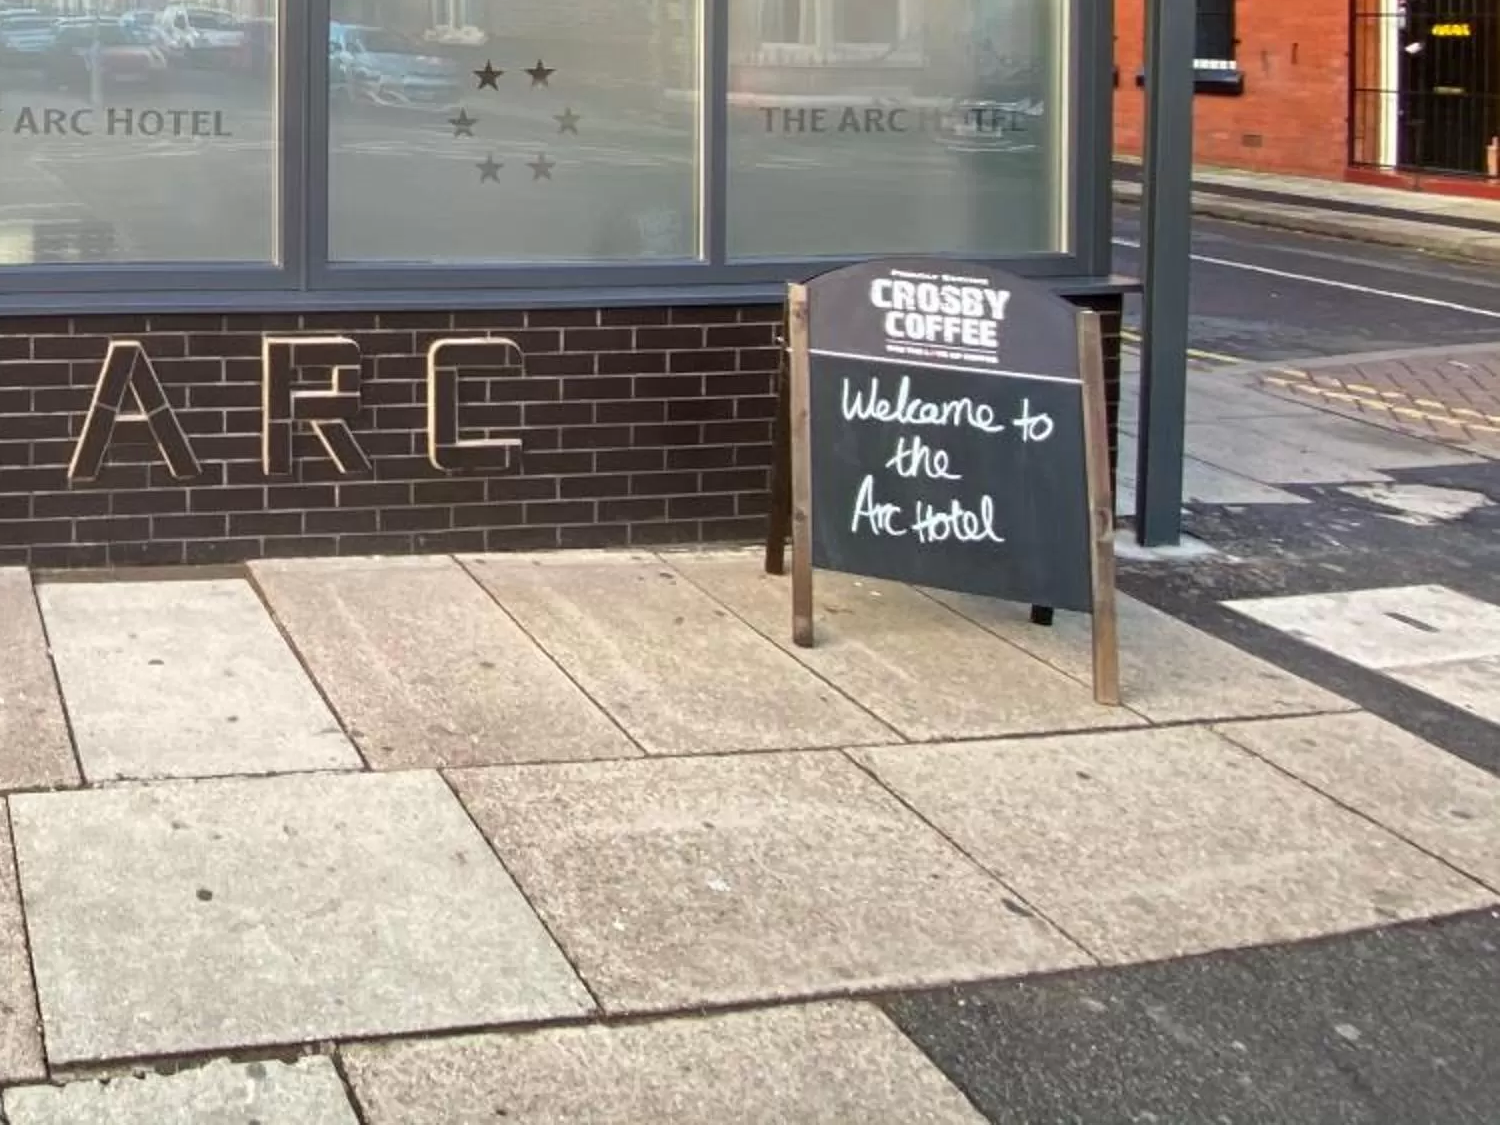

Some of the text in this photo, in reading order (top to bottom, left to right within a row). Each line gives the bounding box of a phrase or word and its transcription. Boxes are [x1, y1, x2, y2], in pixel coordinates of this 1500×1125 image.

[12, 106, 94, 137] ARC
[106, 107, 233, 137] HOTEL
[759, 106, 828, 133] THE
[836, 106, 909, 133] ARC
[869, 277, 1011, 320] CROSBY
[884, 310, 999, 348] COFFEE
[67, 337, 526, 482] ARC
[841, 375, 1054, 442] Welcome to
[885, 435, 962, 480] the
[851, 474, 1005, 544] Arc Hotel
